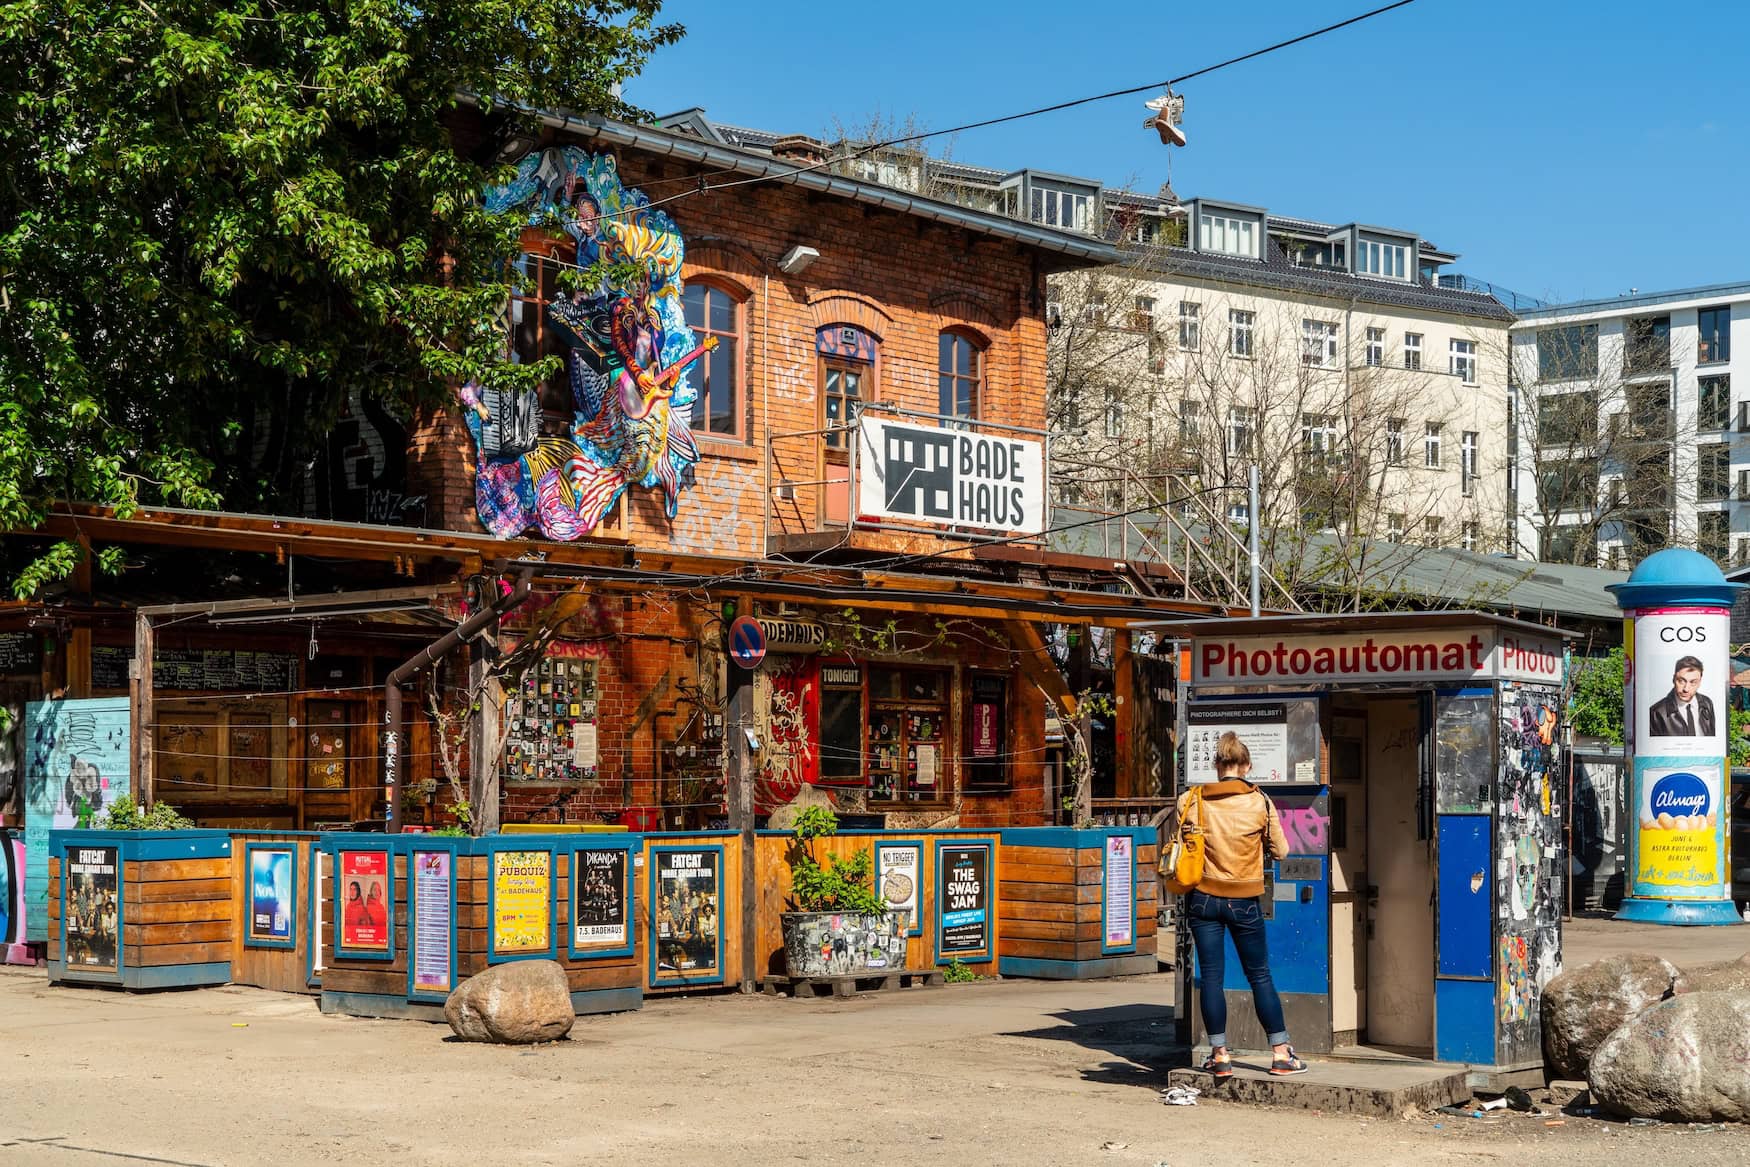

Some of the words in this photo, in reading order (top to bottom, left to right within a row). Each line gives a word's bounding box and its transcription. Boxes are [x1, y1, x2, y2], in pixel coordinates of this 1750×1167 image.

[960, 436, 1024, 483] BADE
[960, 480, 1024, 527] HAUS
[1660, 626, 1706, 643] COS
[1202, 634, 1484, 678] Photoautomat
[1503, 638, 1556, 674] Photo
[823, 668, 859, 683] TONIGHT
[1190, 710, 1242, 719] PHOTOGRAPHIERE
[1242, 709, 1257, 718] DICH
[1257, 708, 1278, 717] SELBST
[79, 850, 107, 865] FATCAT
[586, 851, 618, 866] DIKANDA
[671, 854, 703, 869] FATCAT
[883, 852, 892, 862] NO
[499, 866, 545, 876] PUBQUIZ
[953, 868, 975, 882] THE
[508, 887, 543, 895] BADEHAUS
[948, 881, 980, 896] SWAG
[950, 894, 977, 909] JAM
[591, 926, 623, 935] BADEHAUS
